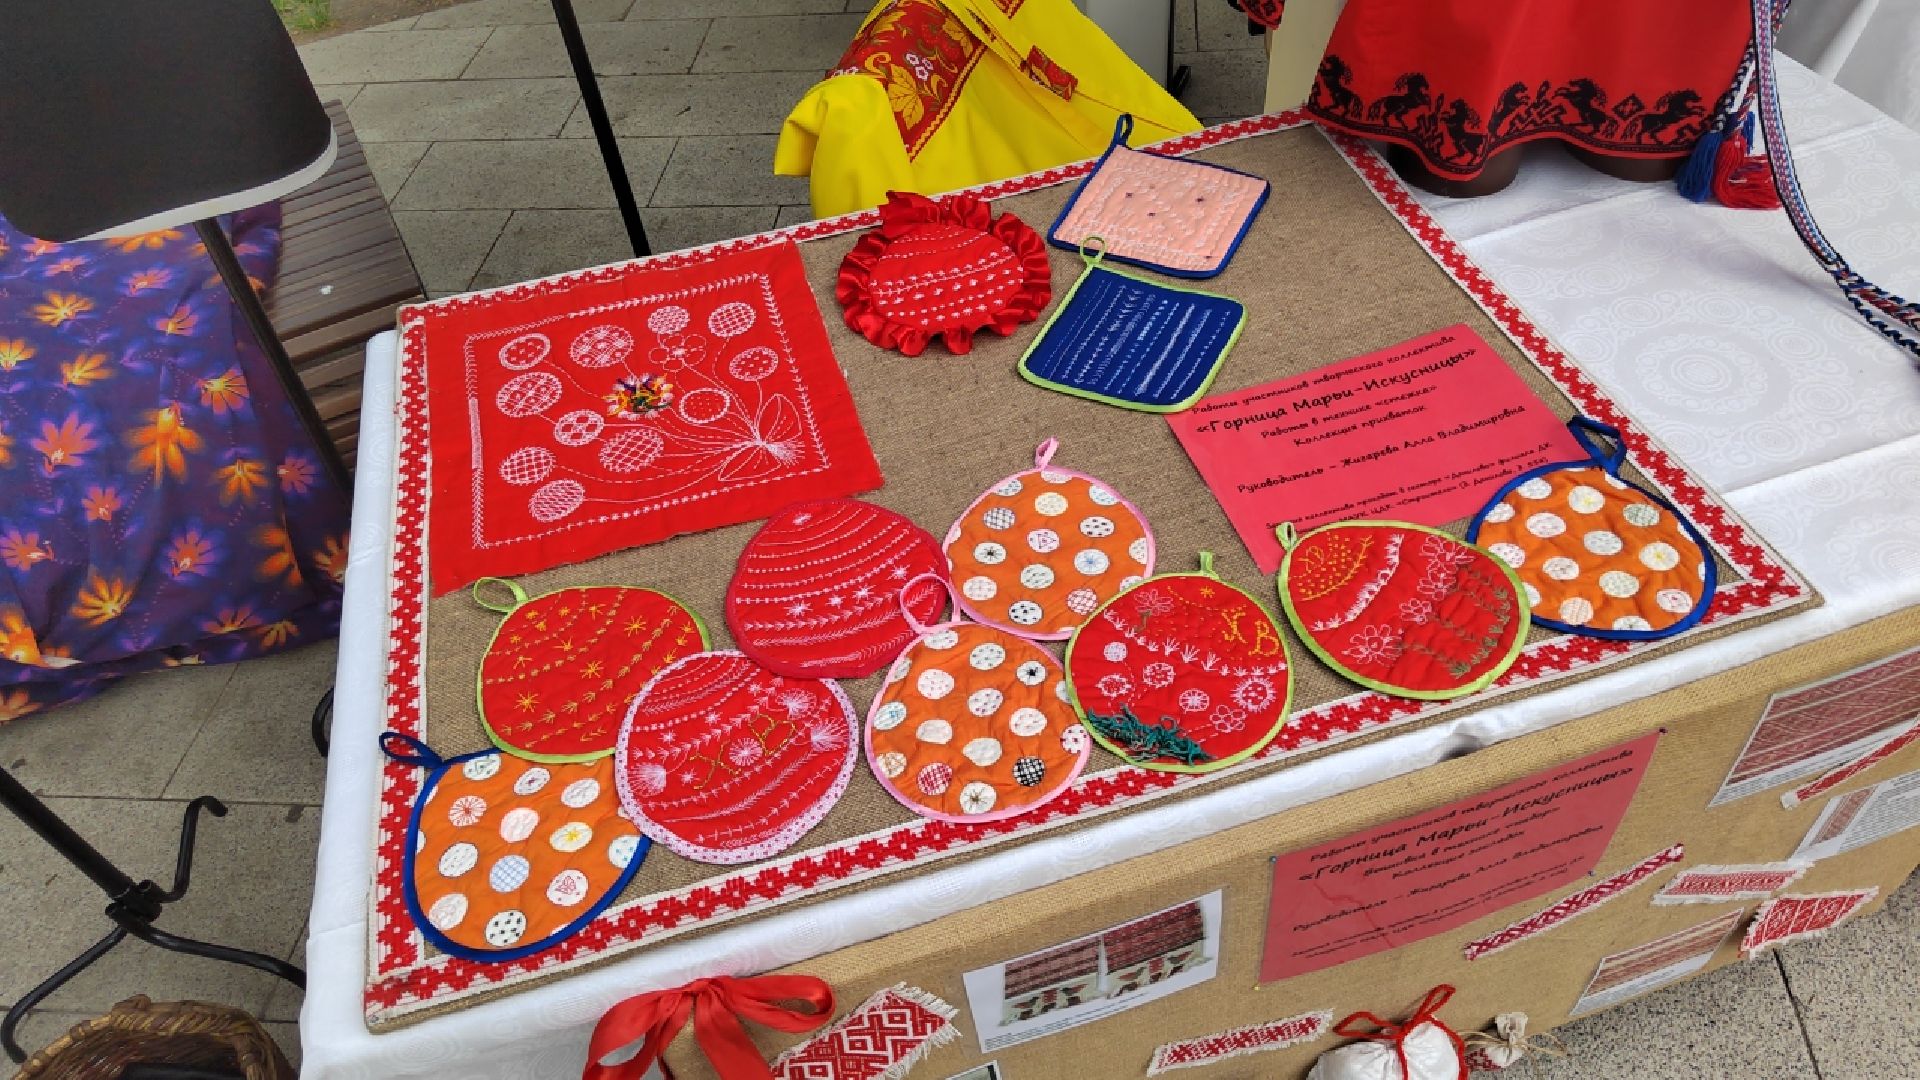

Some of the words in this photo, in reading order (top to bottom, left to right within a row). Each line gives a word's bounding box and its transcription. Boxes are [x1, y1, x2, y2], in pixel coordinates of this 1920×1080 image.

[1189, 401, 1238, 414] Работы
[1242, 380, 1309, 405] участников
[1312, 361, 1383, 385] творческого
[1387, 336, 1456, 364] коллектива
[1197, 408, 1288, 432] «Горница
[1292, 349, 1476, 412] Марьи-Искусницы»
[1237, 468, 1324, 493] Руководитель
[1404, 436, 1435, 449] Алла
[1437, 405, 1525, 439] Владимировна
[1261, 423, 1309, 438] Работы
[1311, 417, 1319, 425] в
[1361, 405, 1425, 427] прихваток
[1299, 844, 1407, 880] «Горница
[1416, 768, 1633, 847] Марьи-Искусницы»
